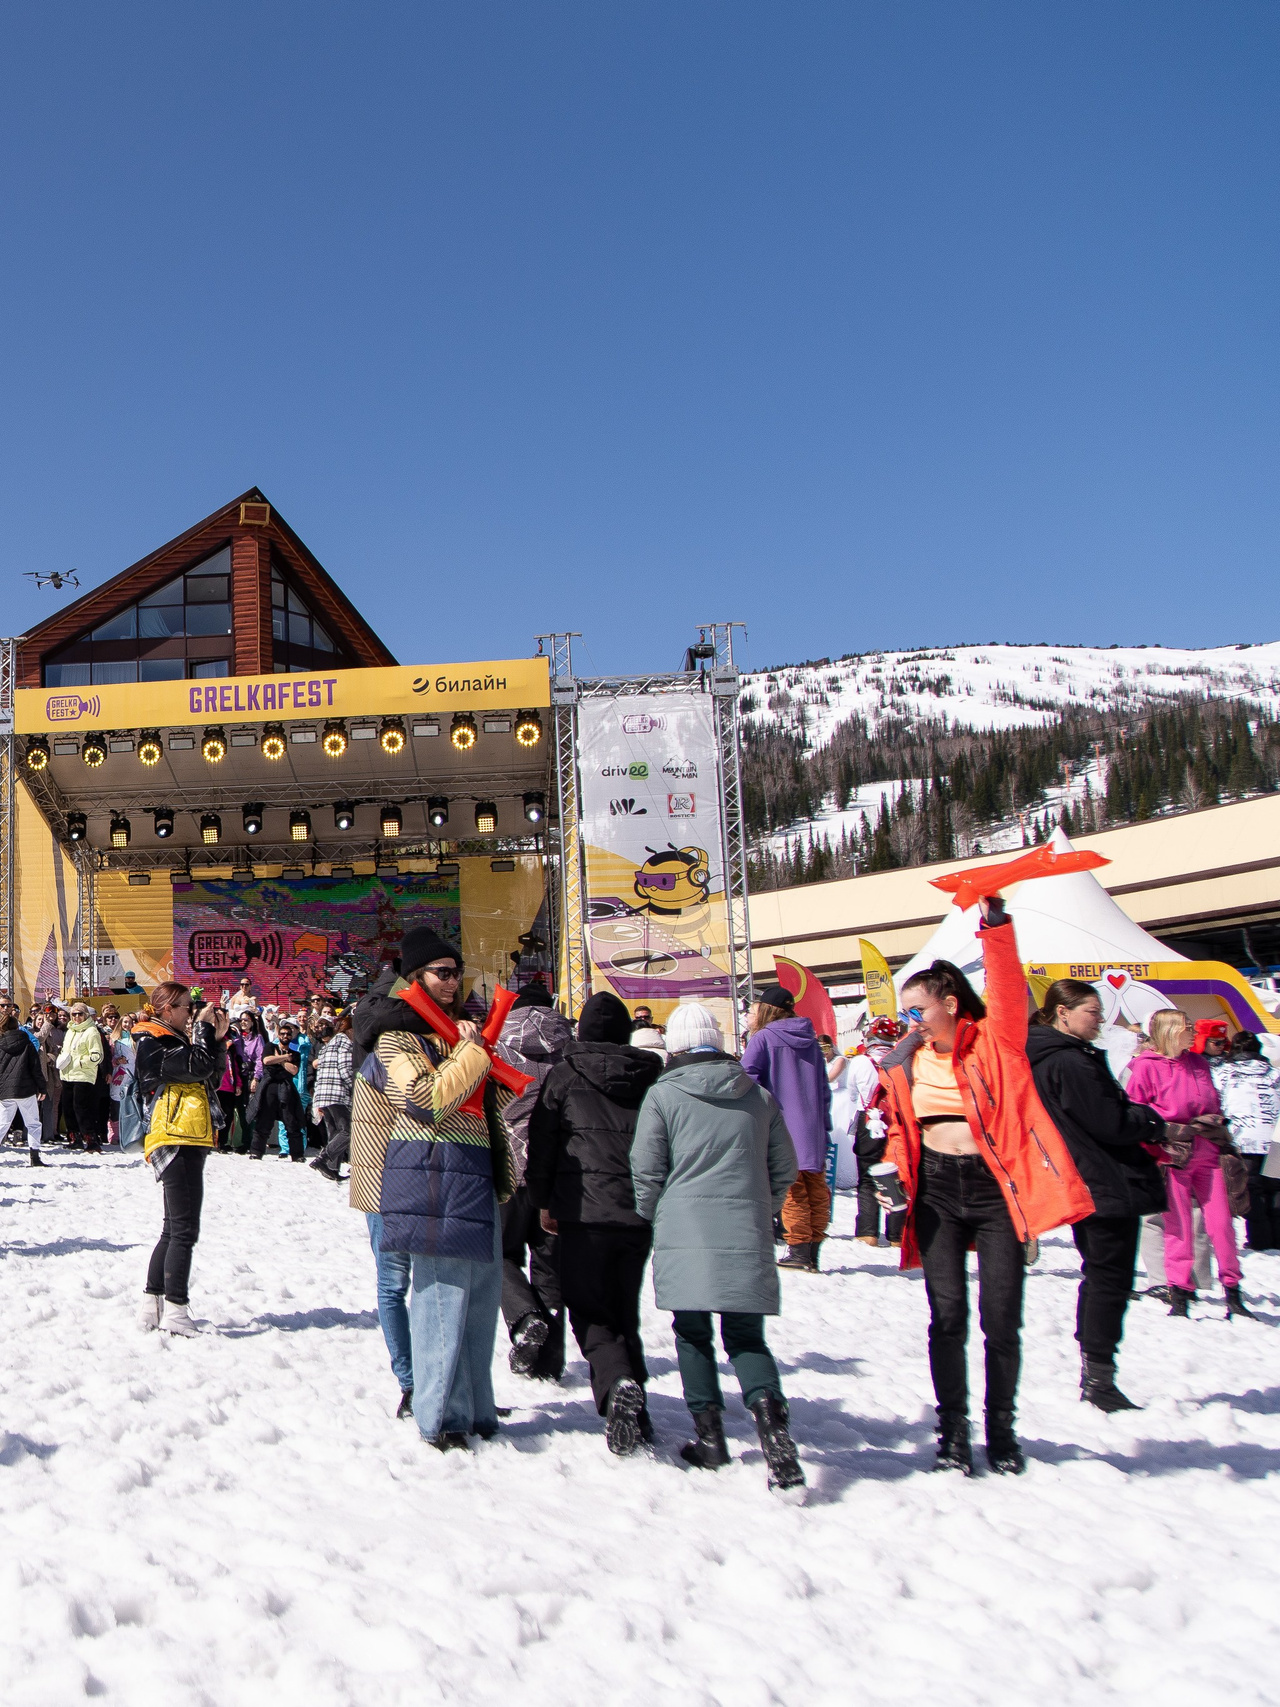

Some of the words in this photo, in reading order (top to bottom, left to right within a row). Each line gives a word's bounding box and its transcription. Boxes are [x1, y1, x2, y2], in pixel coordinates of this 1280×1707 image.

[435, 674, 507, 693] билайн
[189, 679, 337, 713] GRELKAFEST
[51, 698, 78, 709] GRELKA
[51, 708, 69, 718] FEST
[601, 764, 649, 778] drivee
[197, 936, 241, 950] GRELKA
[197, 952, 228, 966] FEST
